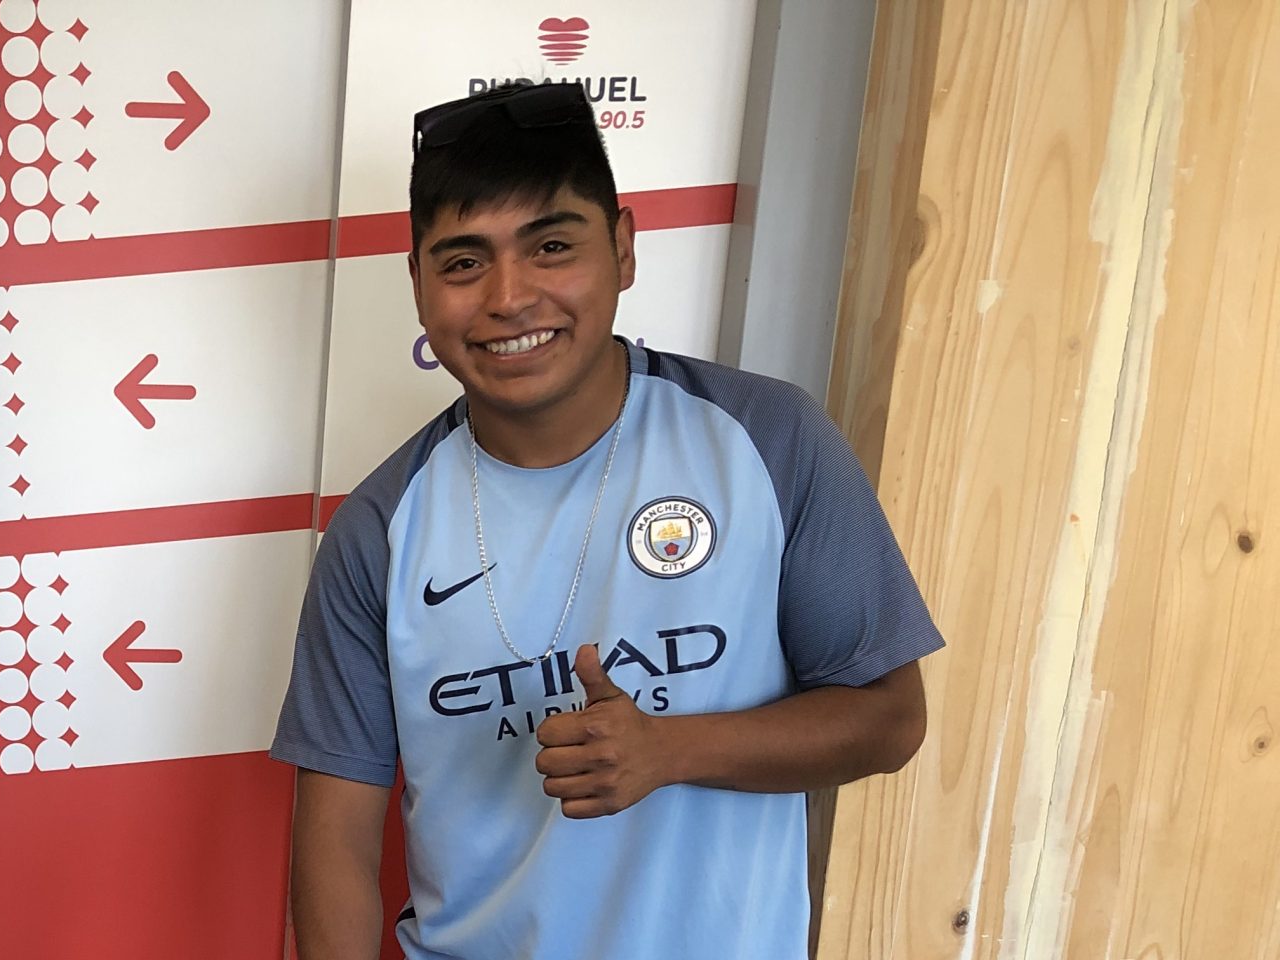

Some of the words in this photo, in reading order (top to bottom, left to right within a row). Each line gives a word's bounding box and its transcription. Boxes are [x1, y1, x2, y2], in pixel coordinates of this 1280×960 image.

[599, 110, 646, 130] 90.5
[636, 503, 704, 532] MANCHESTER
[661, 561, 686, 572] CITY
